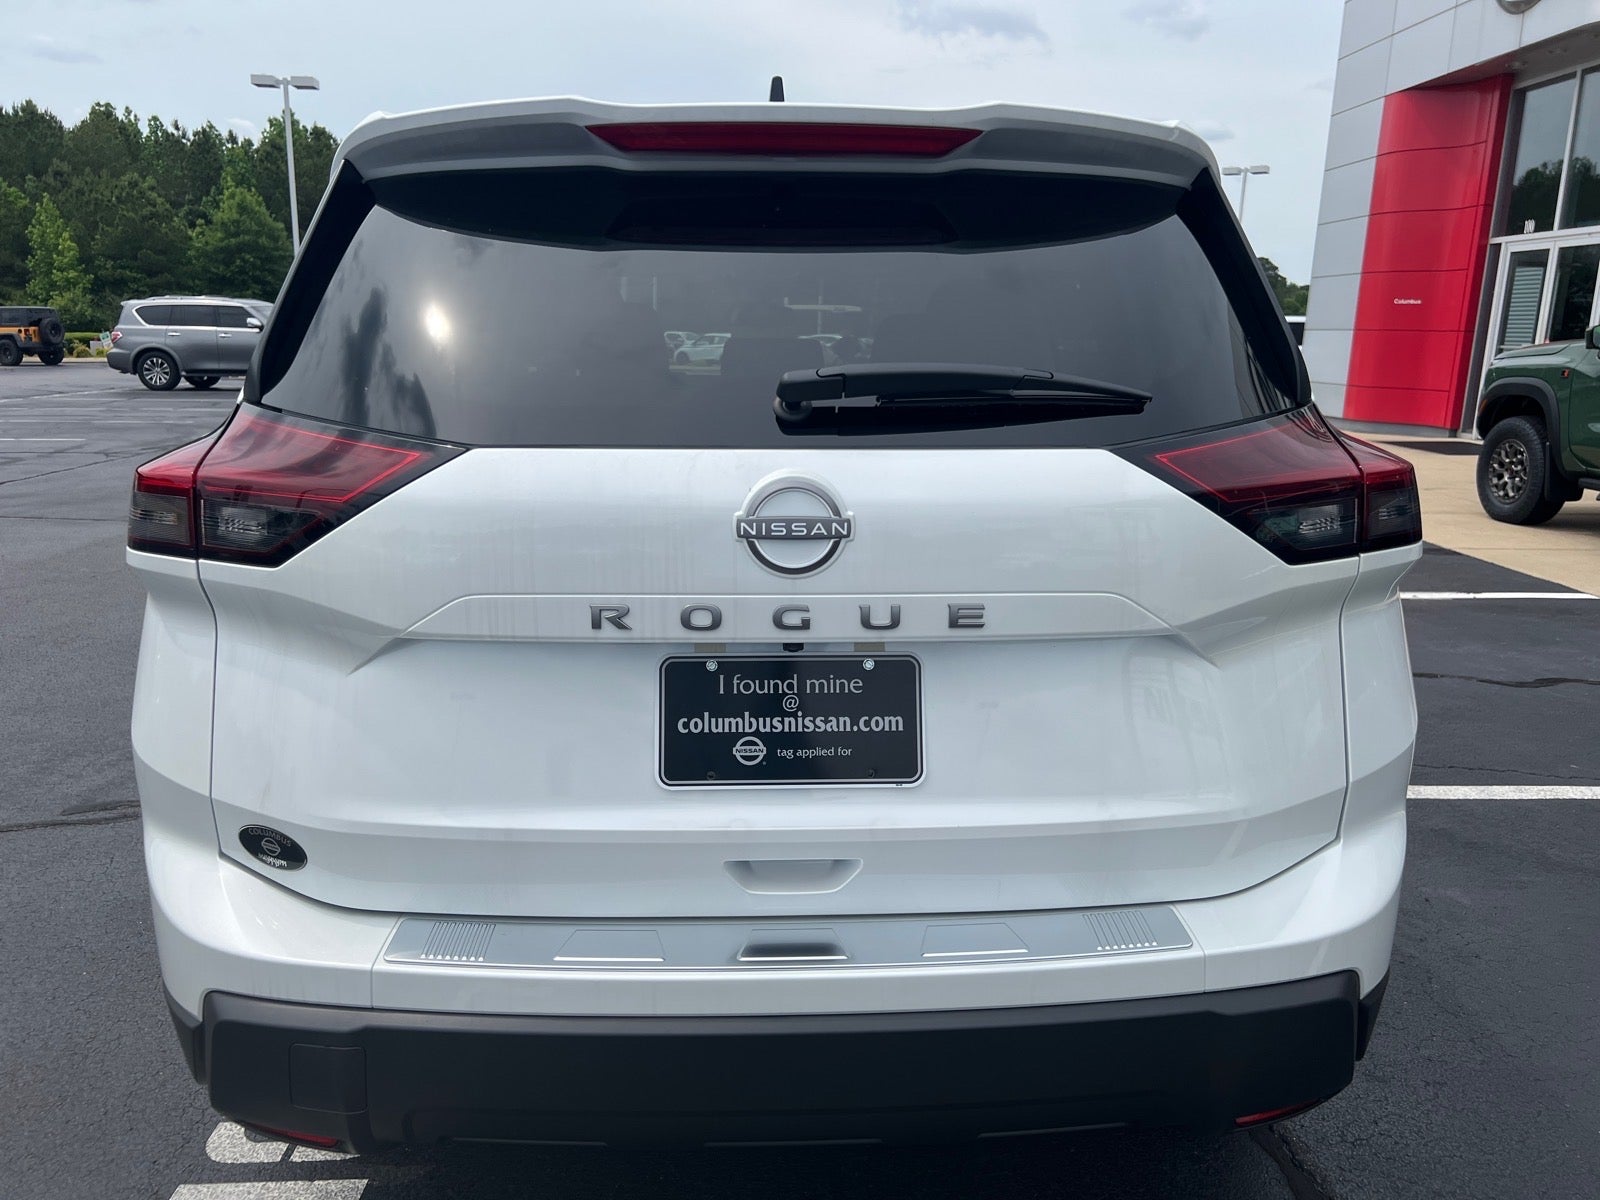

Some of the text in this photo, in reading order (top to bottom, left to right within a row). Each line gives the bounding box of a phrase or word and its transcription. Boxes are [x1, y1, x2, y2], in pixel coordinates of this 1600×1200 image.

[740, 521, 849, 537] NISSAN
[589, 603, 986, 631] ROGUE
[719, 674, 863, 694] I found mine
[782, 694, 800, 712] @
[677, 711, 905, 733] columbusnissan.com
[777, 746, 853, 759] tag applied for
[248, 827, 292, 847] COLUMBUS
